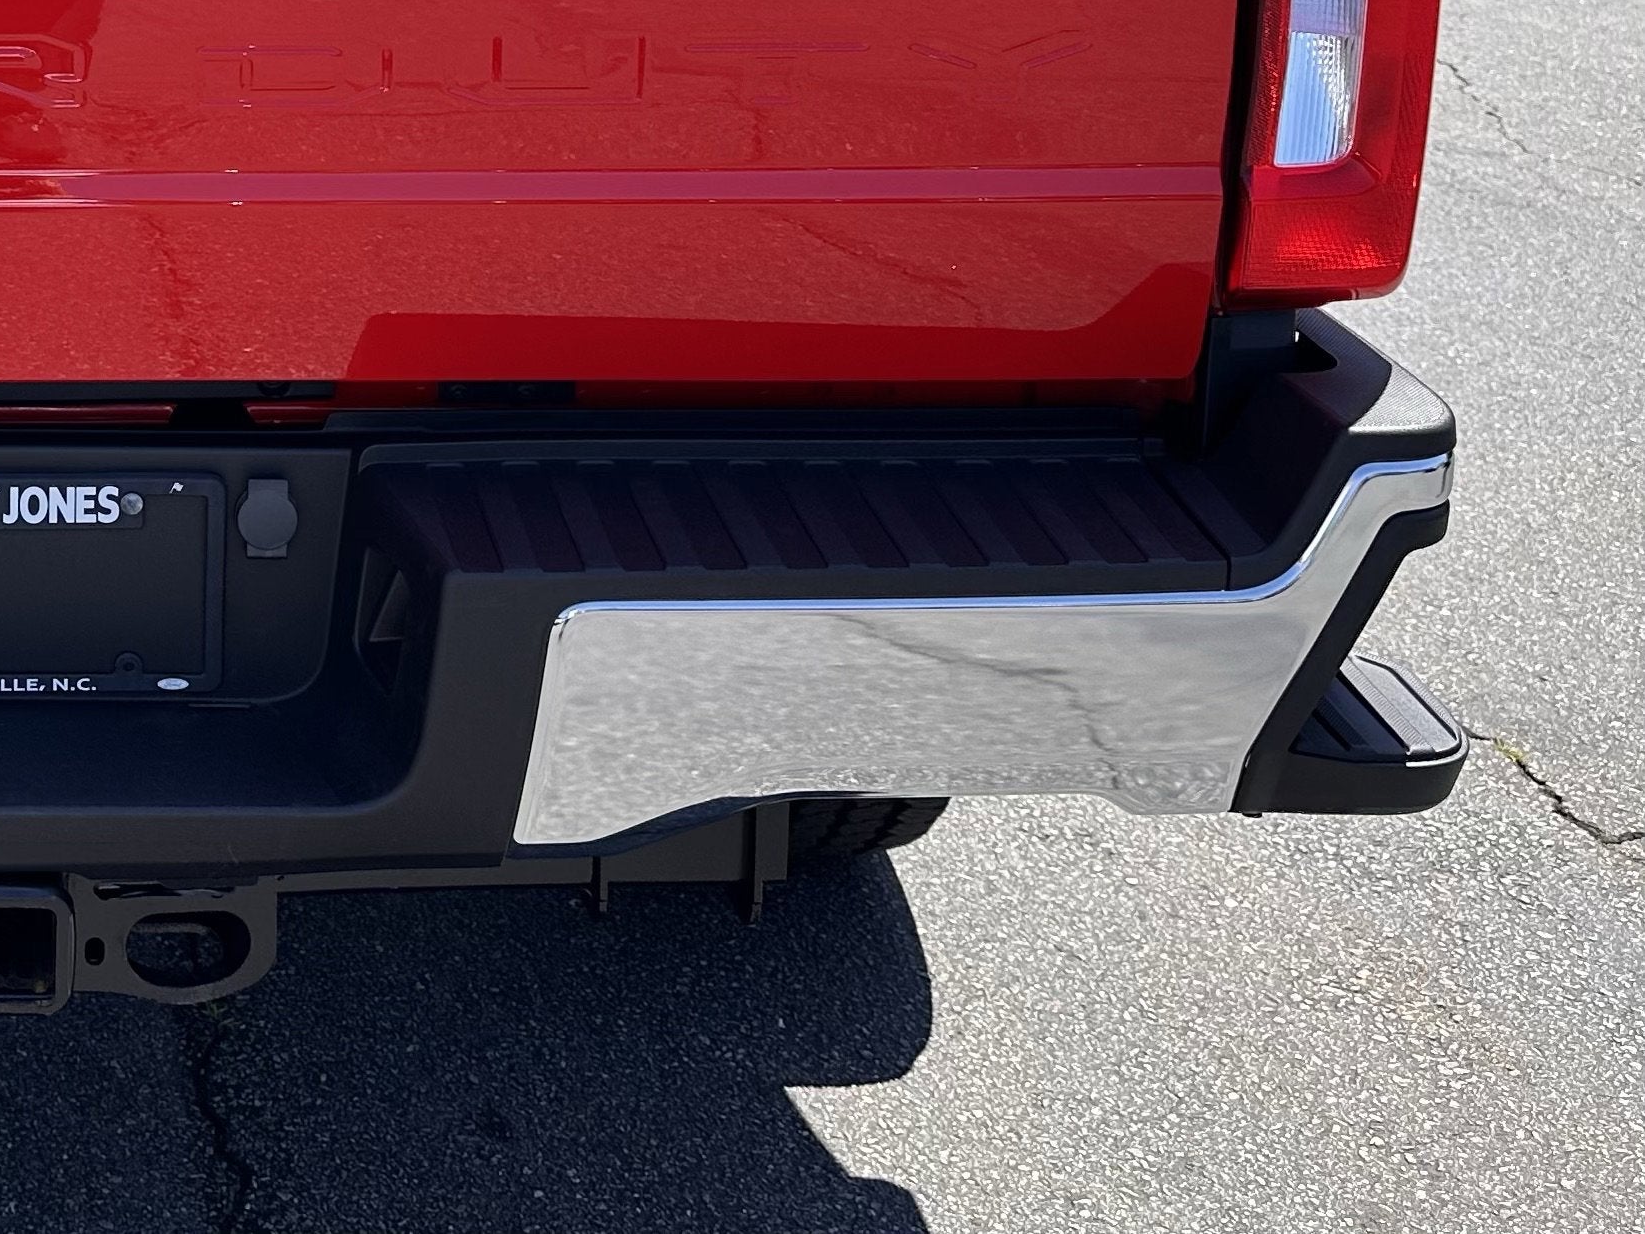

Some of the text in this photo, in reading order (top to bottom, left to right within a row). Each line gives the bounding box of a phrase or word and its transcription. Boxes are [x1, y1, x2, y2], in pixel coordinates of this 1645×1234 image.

[193, 28, 1097, 110] DUTY
[2, 485, 120, 524] JONES
[51, 677, 97, 692] N.C.
